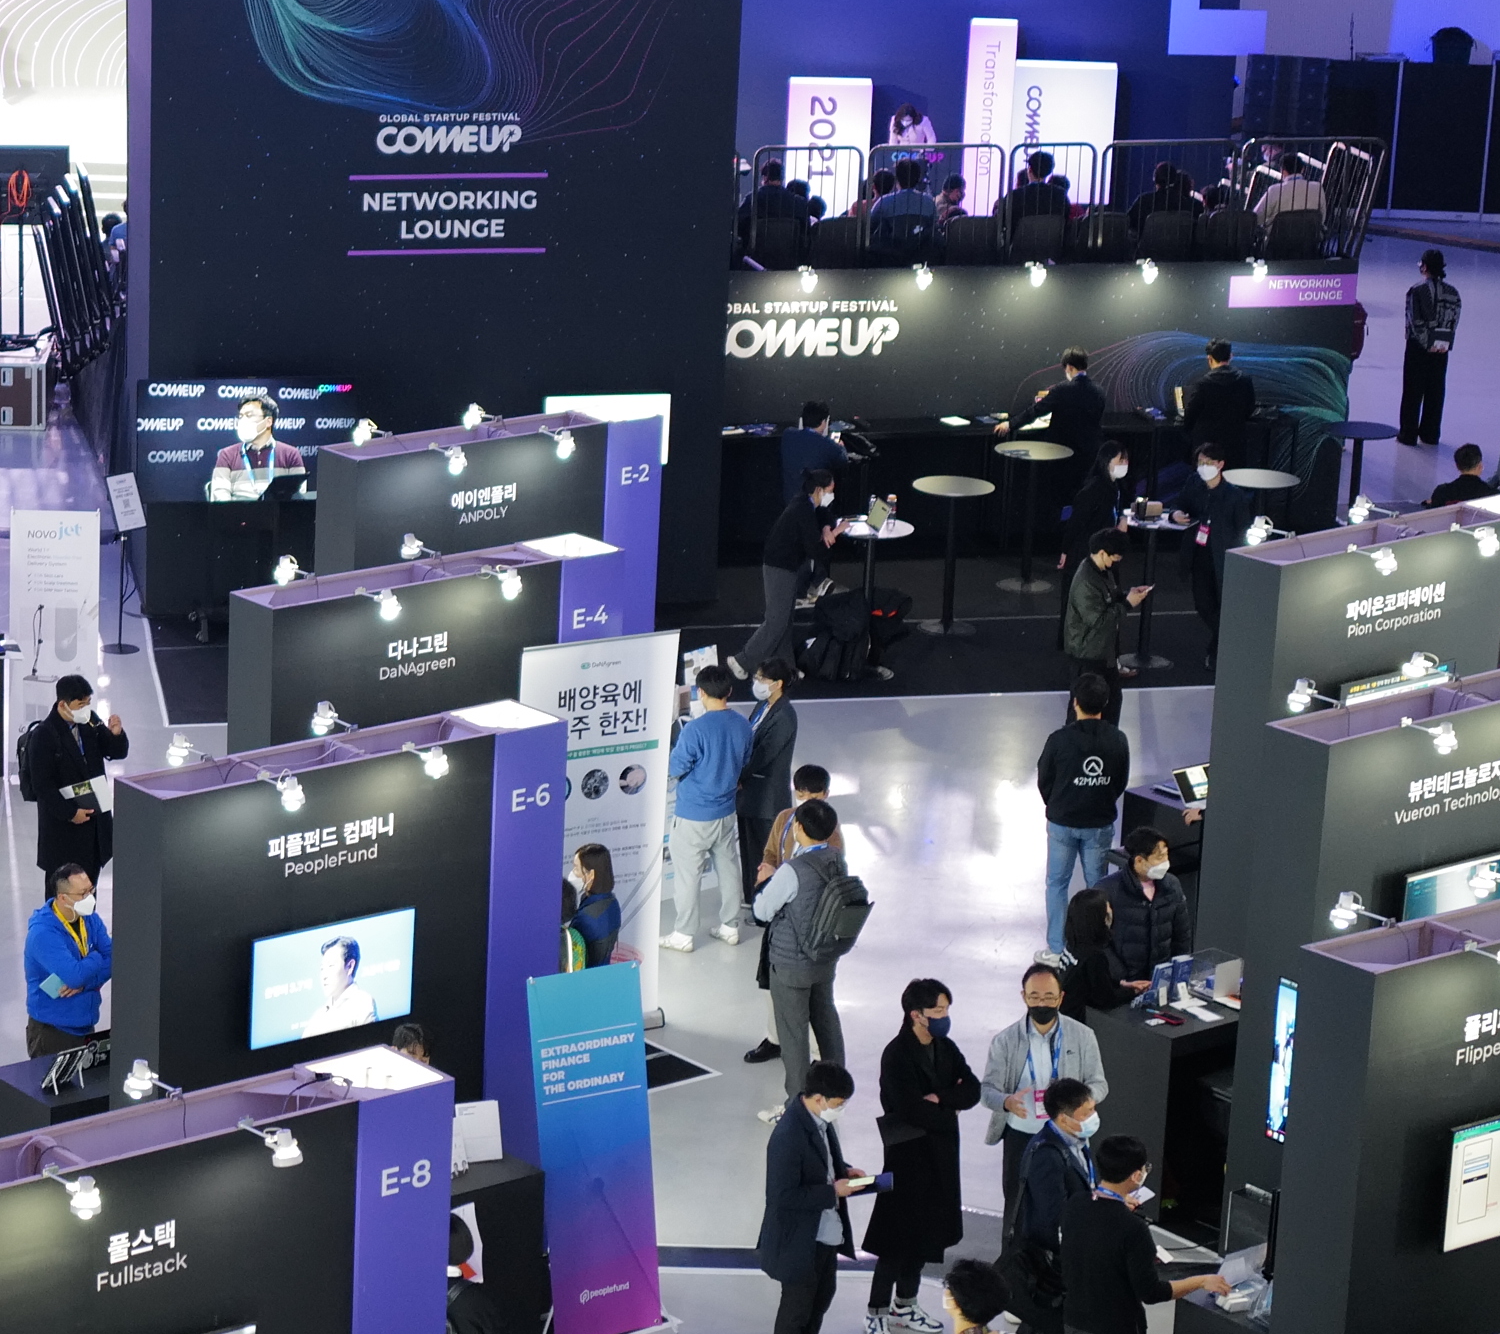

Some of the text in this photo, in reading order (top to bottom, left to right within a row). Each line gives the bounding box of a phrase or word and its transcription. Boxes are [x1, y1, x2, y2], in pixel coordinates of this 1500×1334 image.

[379, 112, 521, 124] GLOBAL STARTUP FESTIVAL
[376, 124, 522, 154] COMEUP
[362, 189, 538, 214] NETWORKING
[400, 218, 505, 241] LOUNGE
[1269, 278, 1342, 291] NETWORKING
[1298, 290, 1343, 302] LOUNGE
[764, 299, 827, 314] STARTUP
[831, 298, 898, 313] FESTIVAL
[148, 449, 204, 464] COMEUP
[620, 464, 650, 487] E-2
[450, 482, 518, 512] 에이엔폴리
[459, 504, 508, 526] ANPOLY
[27, 521, 83, 541] NOVO jet
[1345, 581, 1447, 621] 파이온코퍼레이션
[573, 605, 609, 631] E-4
[1347, 607, 1442, 638] Pion Corporation
[387, 630, 449, 661] 다나그린
[379, 654, 457, 682] DaNAgreen
[557, 679, 642, 713] 배양육에
[1073, 775, 1112, 787] 42MARU
[511, 784, 551, 814] E-6
[1394, 800, 1448, 827] Vueron
[267, 811, 396, 860] 피플펀드 컴퍼니
[284, 843, 379, 877] PeopleFund
[541, 1031, 636, 1061] EXTRAORDINARY
[542, 1052, 591, 1072] FINANCE
[543, 1069, 566, 1083] FOR
[544, 1070, 625, 1096] THE ORDINARY
[381, 1159, 432, 1198] E-8
[107, 1219, 177, 1265] 풀스택
[95, 1250, 188, 1292] Fullstack
[591, 1280, 631, 1302] peoplefund
